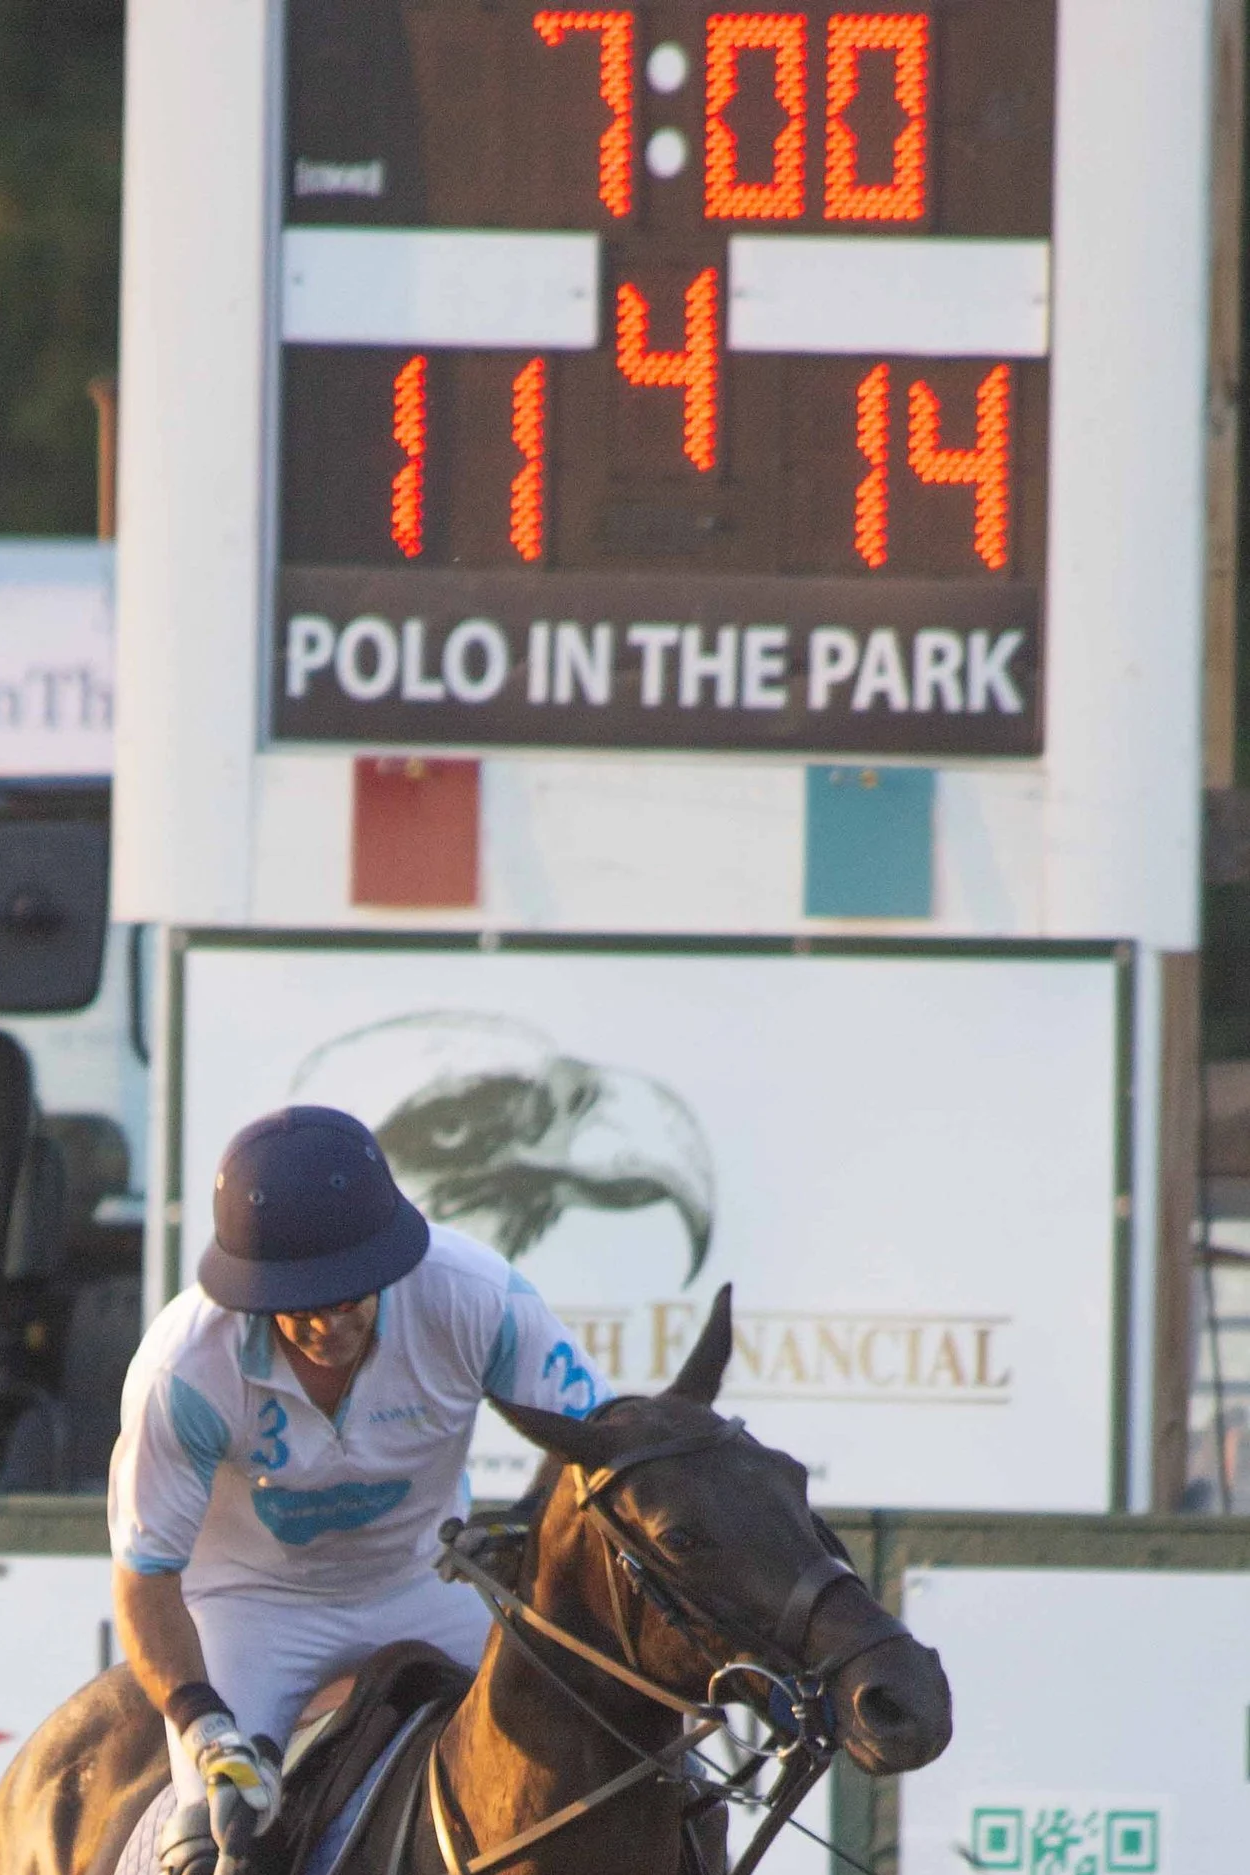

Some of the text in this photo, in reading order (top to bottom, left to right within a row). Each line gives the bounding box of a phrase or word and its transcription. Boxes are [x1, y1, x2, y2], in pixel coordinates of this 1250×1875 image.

[532, 10, 932, 223] 7:00
[616, 268, 720, 473] 4
[854, 363, 1012, 572] 14
[286, 615, 1025, 716] POLO IN THE PARK
[541, 1340, 595, 1420] 3
[650, 1302, 1013, 1389] FNANCIAL
[250, 1396, 290, 1470] 3
